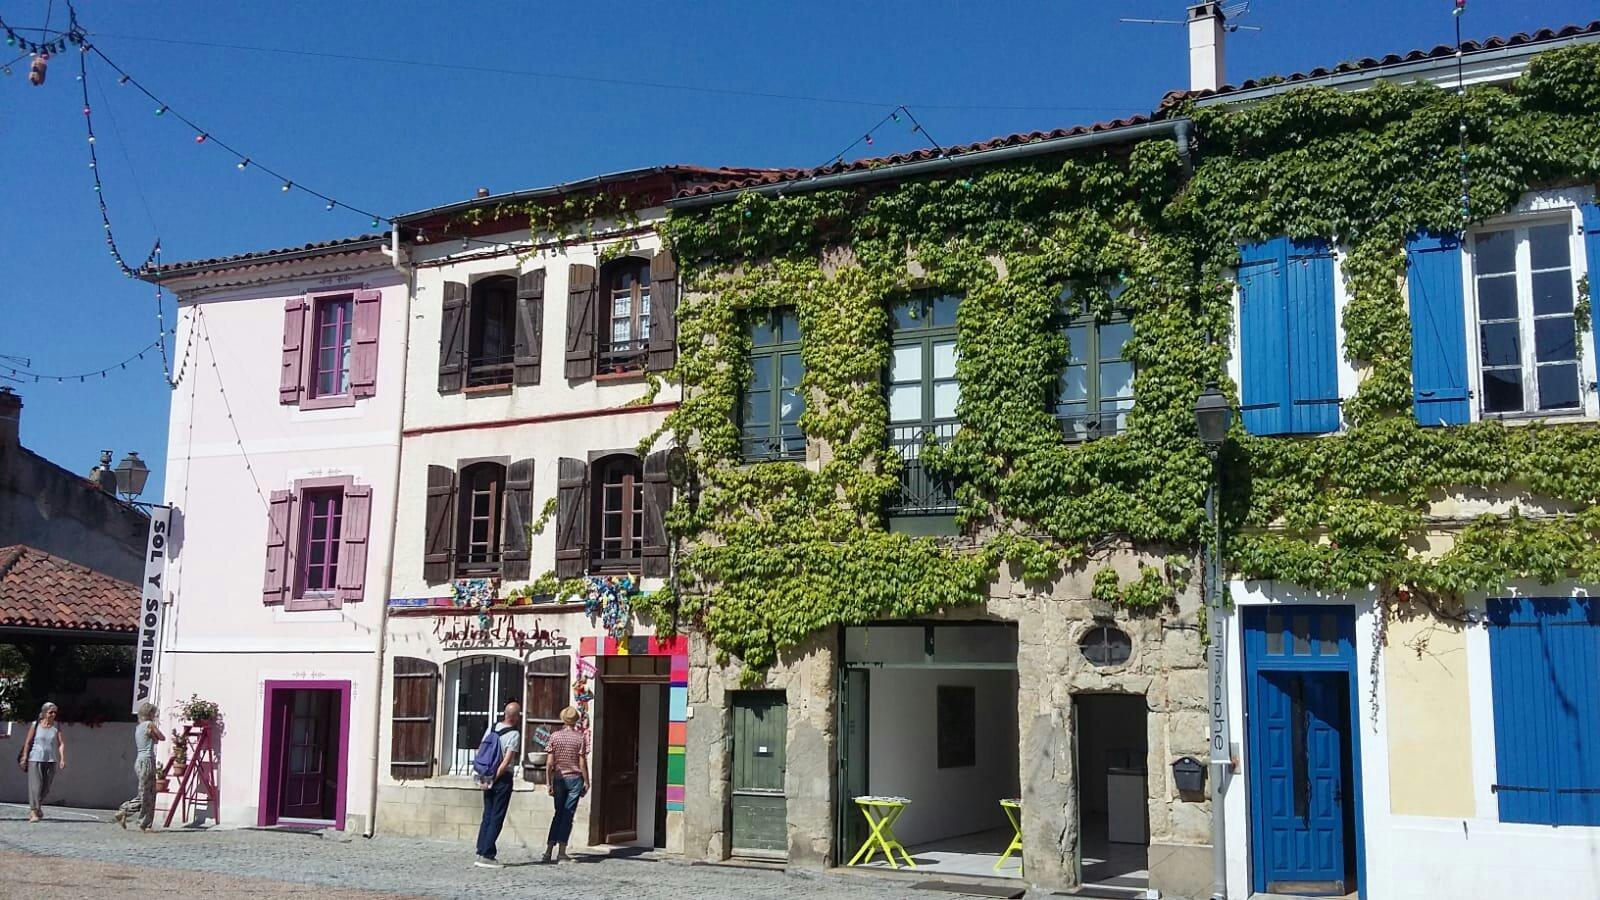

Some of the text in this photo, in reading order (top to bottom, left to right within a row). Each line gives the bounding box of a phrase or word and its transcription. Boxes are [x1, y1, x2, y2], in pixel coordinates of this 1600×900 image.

[137, 520, 165, 701] SOL Y SOMBRA
